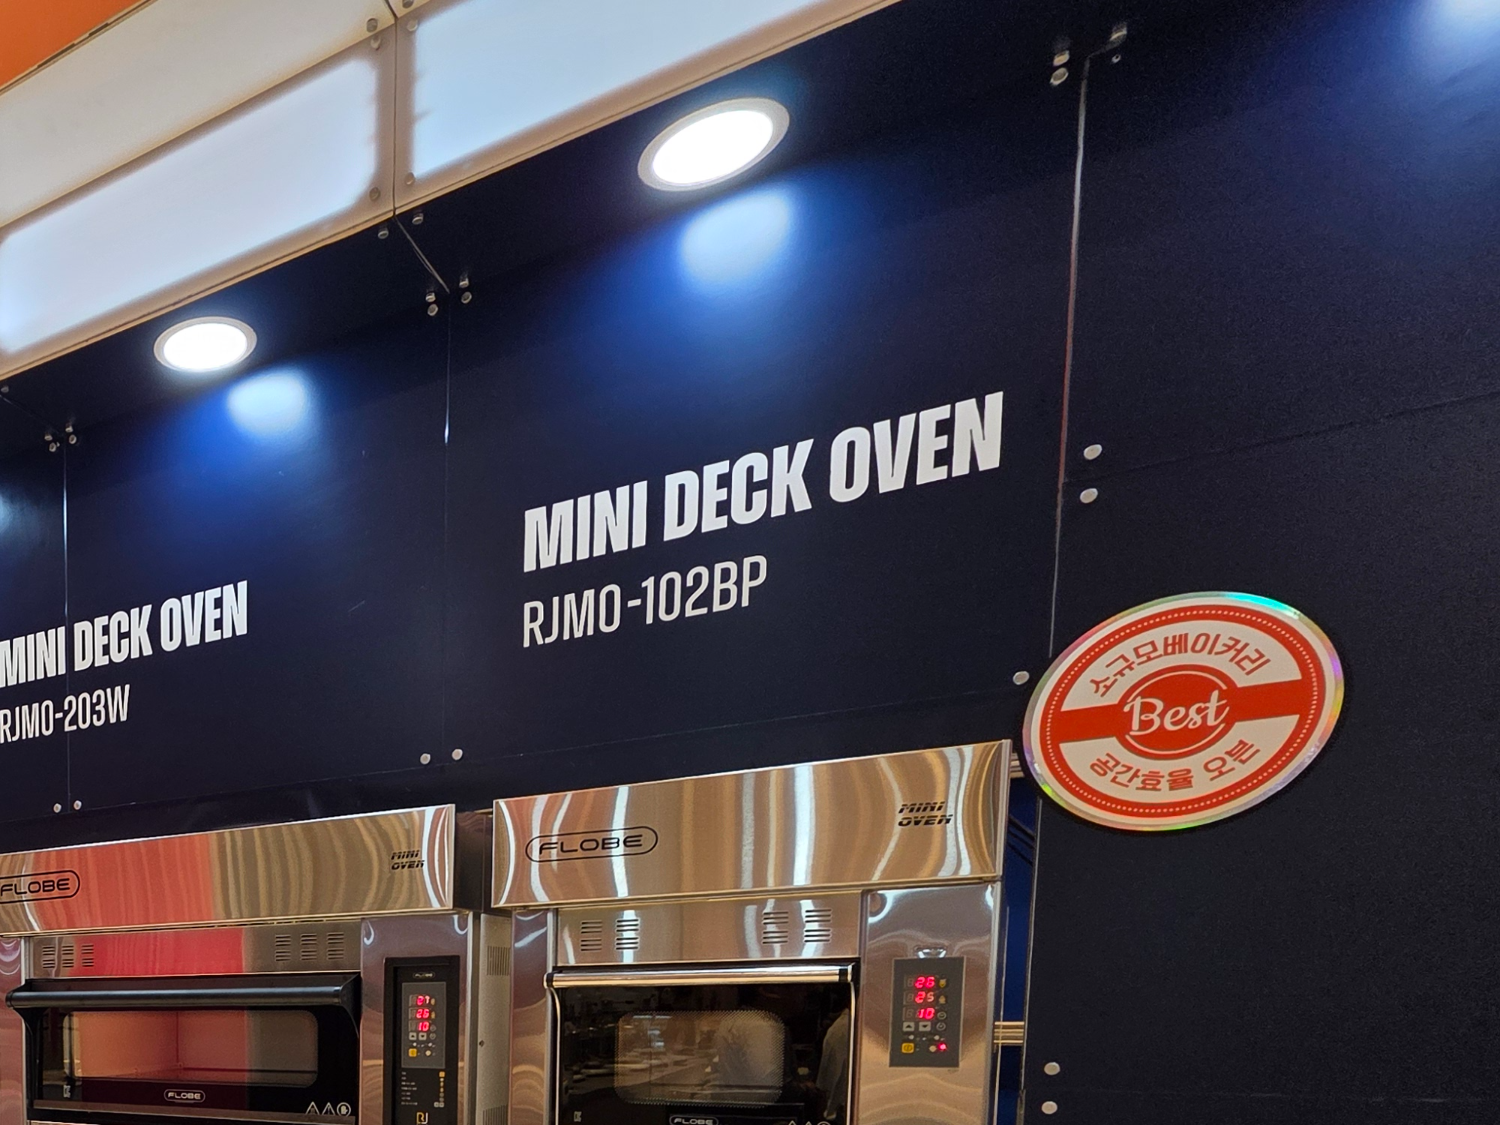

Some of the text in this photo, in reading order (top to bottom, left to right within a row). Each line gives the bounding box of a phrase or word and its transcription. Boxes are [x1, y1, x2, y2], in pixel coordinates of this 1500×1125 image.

[523, 391, 1003, 572] MINI DECK OVEN
[523, 555, 767, 648] RJMO-102BP
[74, 604, 153, 672] DECK
[160, 580, 248, 652] OVEN
[1089, 632, 1271, 698] 소규모베이커리
[0, 684, 130, 744] RJMO-203W
[1123, 690, 1230, 735] Best
[1090, 739, 1261, 791] 공간효율 오븐
[898, 801, 946, 814] MINI
[898, 814, 953, 827] OVEN
[538, 834, 643, 855] FLOBE
[391, 859, 424, 871] OVEN
[0, 878, 70, 896] FLOBE
[915, 976, 935, 988] 26
[918, 1007, 935, 1019] 10
